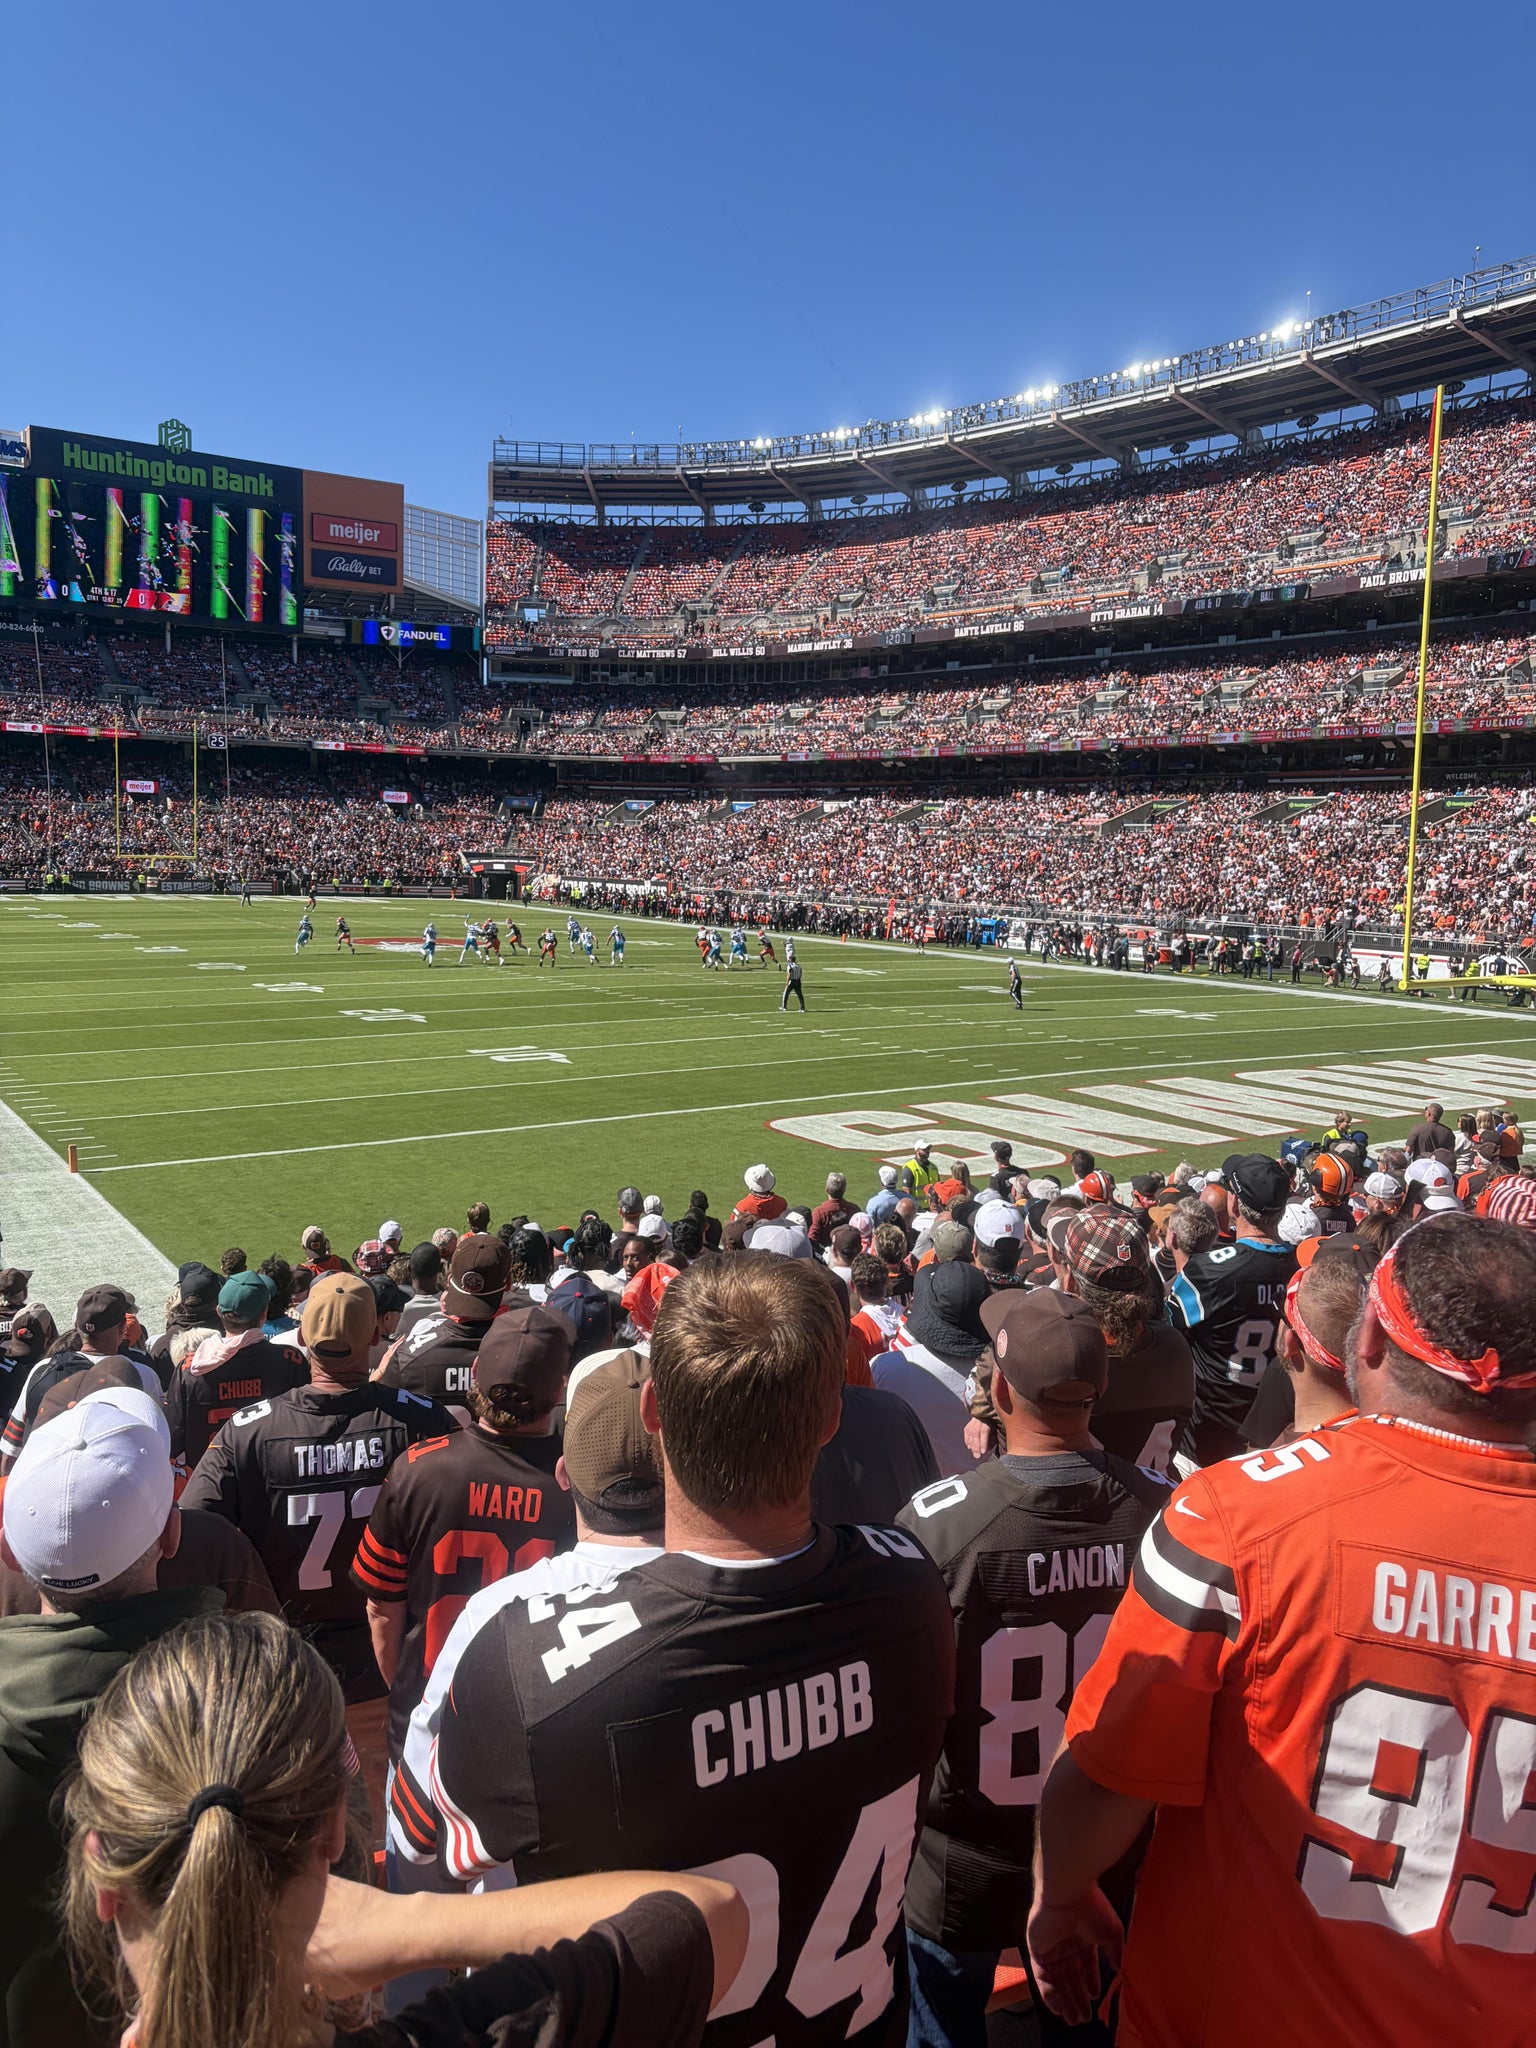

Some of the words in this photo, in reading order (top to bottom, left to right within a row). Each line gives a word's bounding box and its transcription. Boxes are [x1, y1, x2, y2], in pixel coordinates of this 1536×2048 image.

[63, 442, 207, 488] Huntington
[212, 465, 274, 498] Bank
[329, 522, 381, 544] meijer
[327, 556, 368, 578] Bally
[368, 566, 382, 576] BET
[1360, 573, 1386, 589] PAUL
[1389, 568, 1427, 584] BROWN
[61, 584, 69, 597] 0
[90, 586, 103, 596] 4TH
[110, 588, 117, 597] 17
[138, 593, 145, 604] 0
[1090, 611, 1114, 623] OTTO
[1115, 606, 1151, 620] GRAHAM
[1154, 604, 1164, 616] 14
[398, 629, 446, 641] FANDUEL
[954, 625, 979, 638] DANTE
[980, 623, 1011, 635] LAVELLI
[1013, 620, 1025, 632] 86
[549, 649, 564, 657] LEN
[568, 649, 588, 657] FORD
[589, 648, 599, 658] 80
[712, 648, 728, 657] BILL
[729, 647, 754, 656] WILLIS
[755, 646, 765, 656] 60
[787, 643, 812, 653] MARION
[814, 640, 841, 651] MOTLEY
[843, 639, 853, 649] 36
[618, 649, 635, 658] CLAY
[635, 649, 675, 658] MATTHEWS
[677, 649, 687, 658] 57
[1479, 717, 1524, 728] FUELING
[1276, 730, 1312, 739] FUELING
[1334, 726, 1359, 736] DAWG
[1362, 725, 1394, 734] POUND
[210, 736, 225, 747] 25
[1140, 737, 1154, 746] THE
[1156, 736, 1179, 745] DAWG
[1180, 735, 1207, 744] POUND
[963, 745, 990, 754] FUELING
[1445, 772, 1478, 780] WELCOME
[129, 782, 152, 791] meijer
[88, 880, 130, 892] BROWNS
[1482, 961, 1518, 978] 196
[1326, 1219, 1348, 1232] CHUBB
[1208, 1246, 1238, 1264] 8
[218, 1378, 262, 1401] CHUBB
[231, 1399, 272, 1428] 3
[294, 1437, 384, 1478] THOMAS
[469, 1481, 544, 1524] WARD
[1026, 1543, 1125, 1597] CANON
[66, 1577, 94, 1588] LUCKY
[1371, 1560, 1536, 1661] GARRE
[691, 1660, 874, 1788] CHUBB
[1301, 1686, 1536, 1956] 95
